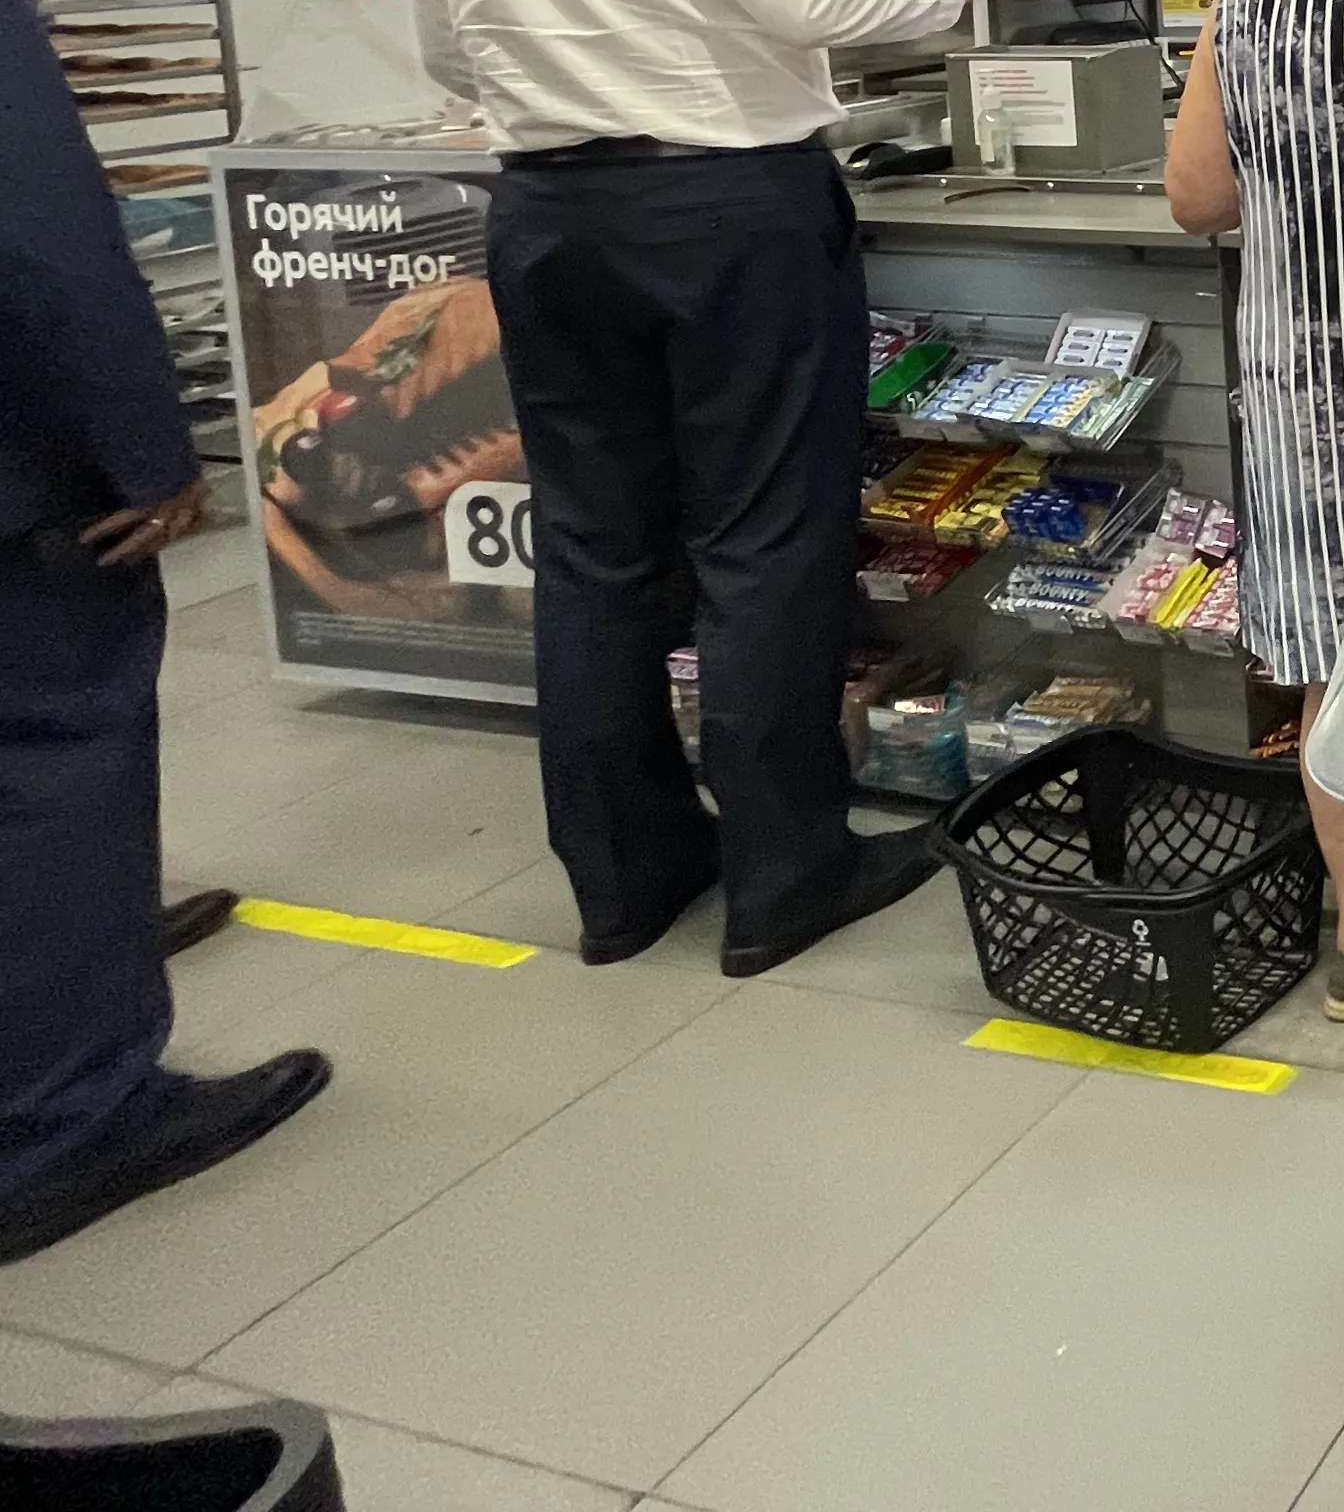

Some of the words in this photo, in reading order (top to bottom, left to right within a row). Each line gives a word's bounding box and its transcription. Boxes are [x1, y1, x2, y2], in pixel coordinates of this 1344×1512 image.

[246, 190, 404, 240] Горячий
[253, 238, 456, 290] френч-дог
[1028, 583, 1089, 602] BOUNTY
